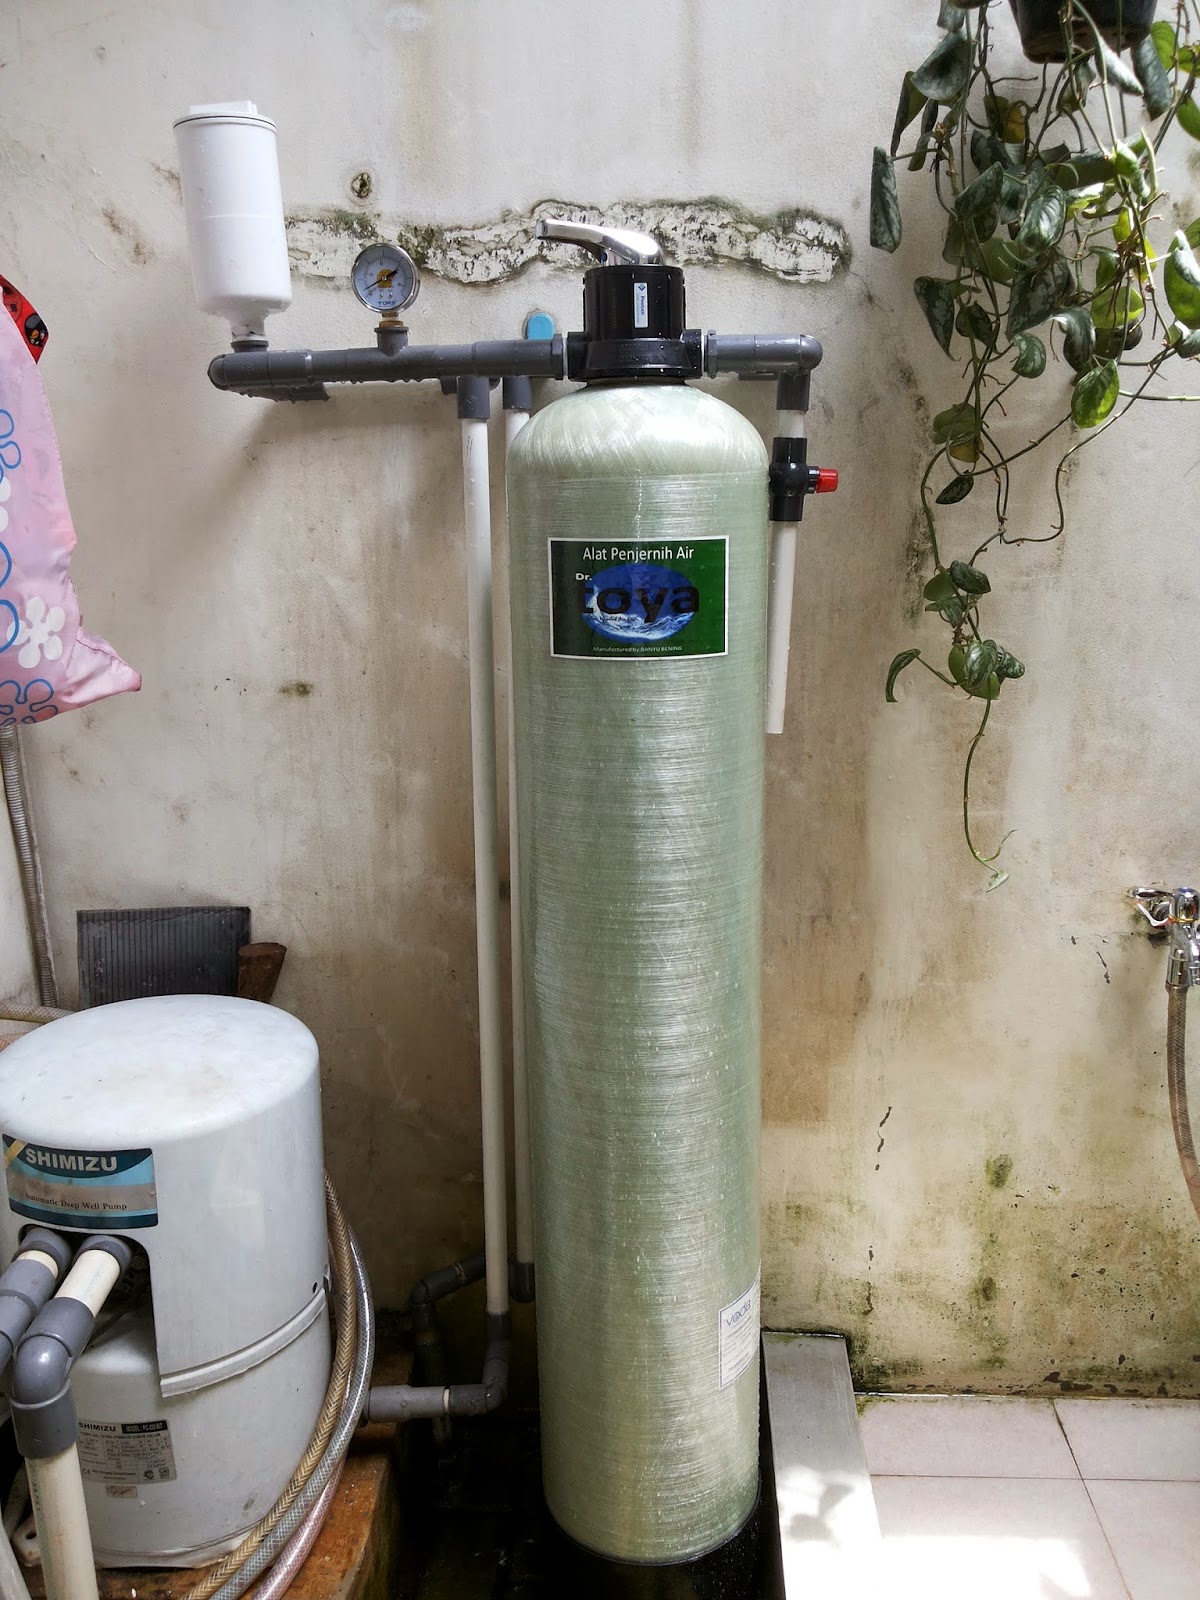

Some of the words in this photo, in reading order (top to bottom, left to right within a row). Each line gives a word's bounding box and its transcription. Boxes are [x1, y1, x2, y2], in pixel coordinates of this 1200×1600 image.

[582, 547, 607, 560] Alat
[611, 546, 673, 563] Penjernih
[676, 546, 695, 560] Air
[575, 572, 592, 581] Dr.
[25, 1148, 117, 1172] SHIMIZU
[25, 1193, 58, 1206] Automatic
[61, 1201, 80, 1210] Deep
[82, 1202, 100, 1210] Well
[103, 1203, 128, 1211] Pump
[79, 1421, 116, 1432] SHIMIZU
